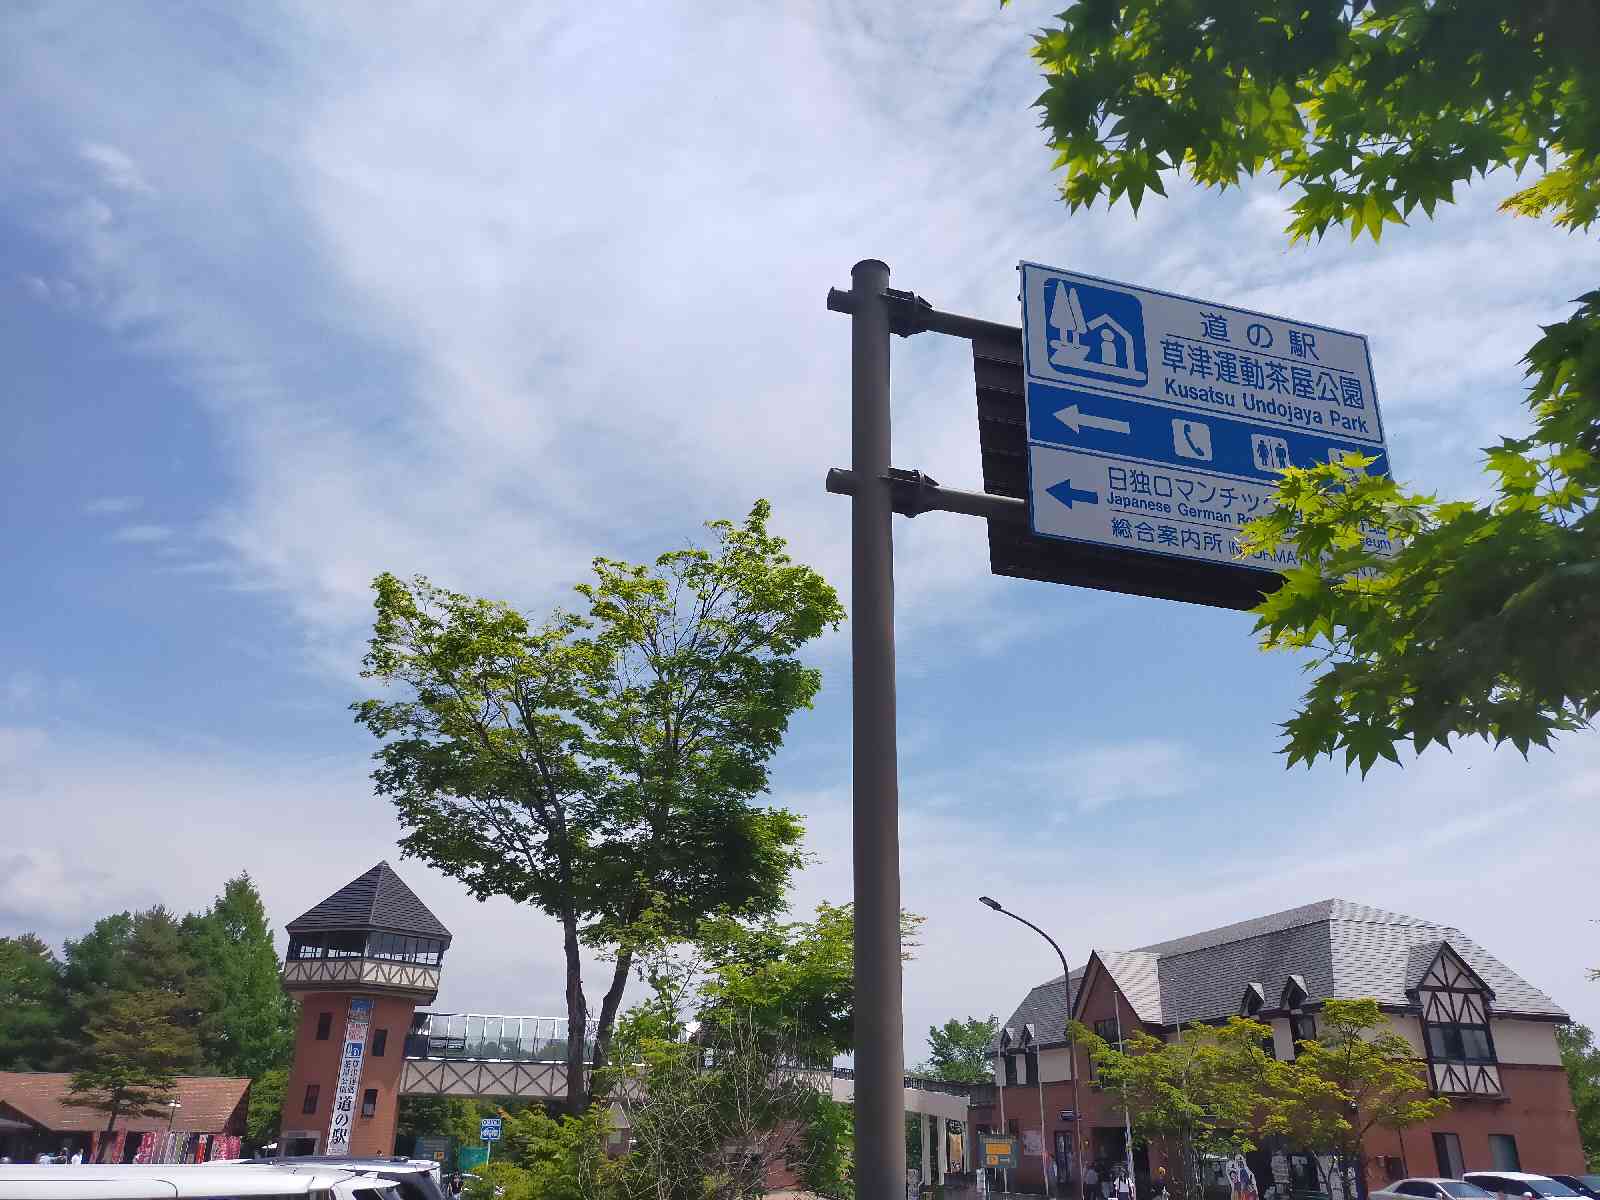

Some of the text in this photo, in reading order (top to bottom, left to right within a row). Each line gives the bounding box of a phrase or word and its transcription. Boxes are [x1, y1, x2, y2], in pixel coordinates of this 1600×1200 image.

[1159, 338, 1365, 410] 草津運動茶屋公園
[1164, 376, 1370, 434] Kusatsu Undojaya Park
[1106, 490, 1172, 514] Japanese
[1177, 502, 1232, 524] German
[1111, 516, 1223, 554] 総合案内所
[329, 1095, 353, 1145] 道の駅
